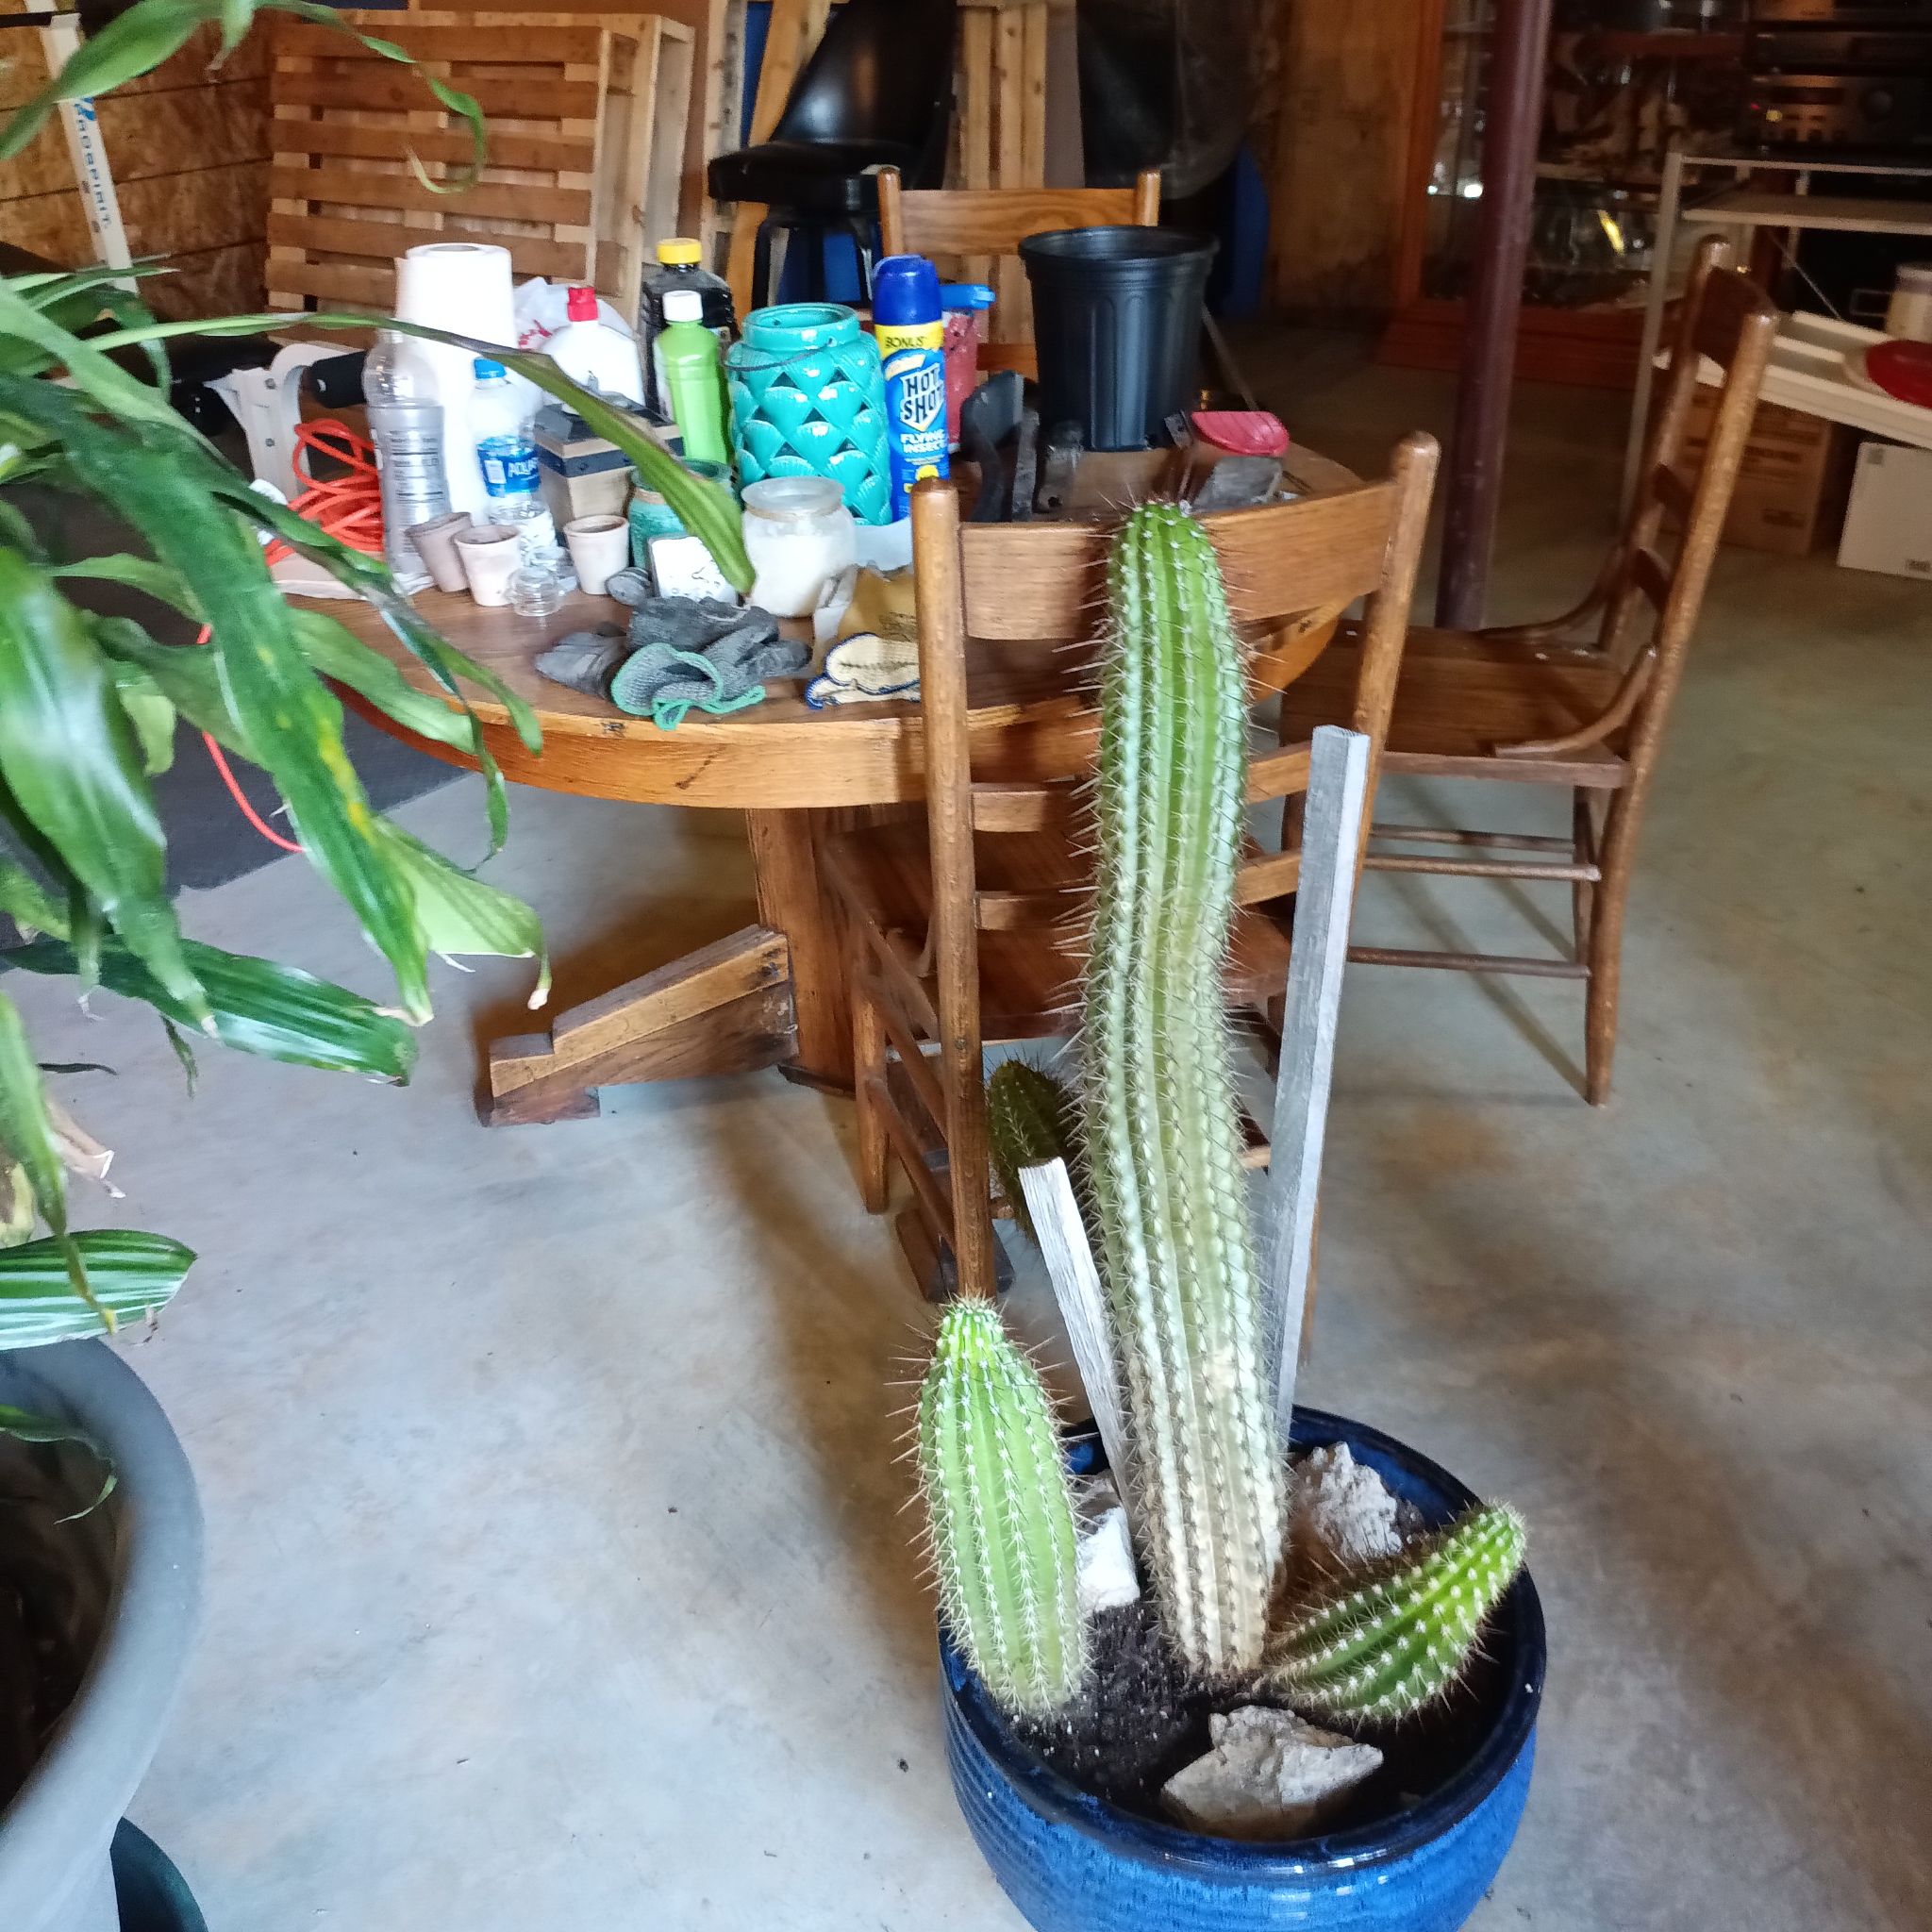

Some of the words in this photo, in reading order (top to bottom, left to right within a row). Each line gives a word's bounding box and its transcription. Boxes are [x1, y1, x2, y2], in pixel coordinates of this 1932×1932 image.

[885, 336, 925, 348] BONUS
[906, 367, 939, 397] HOT
[904, 384, 944, 424] SHOT
